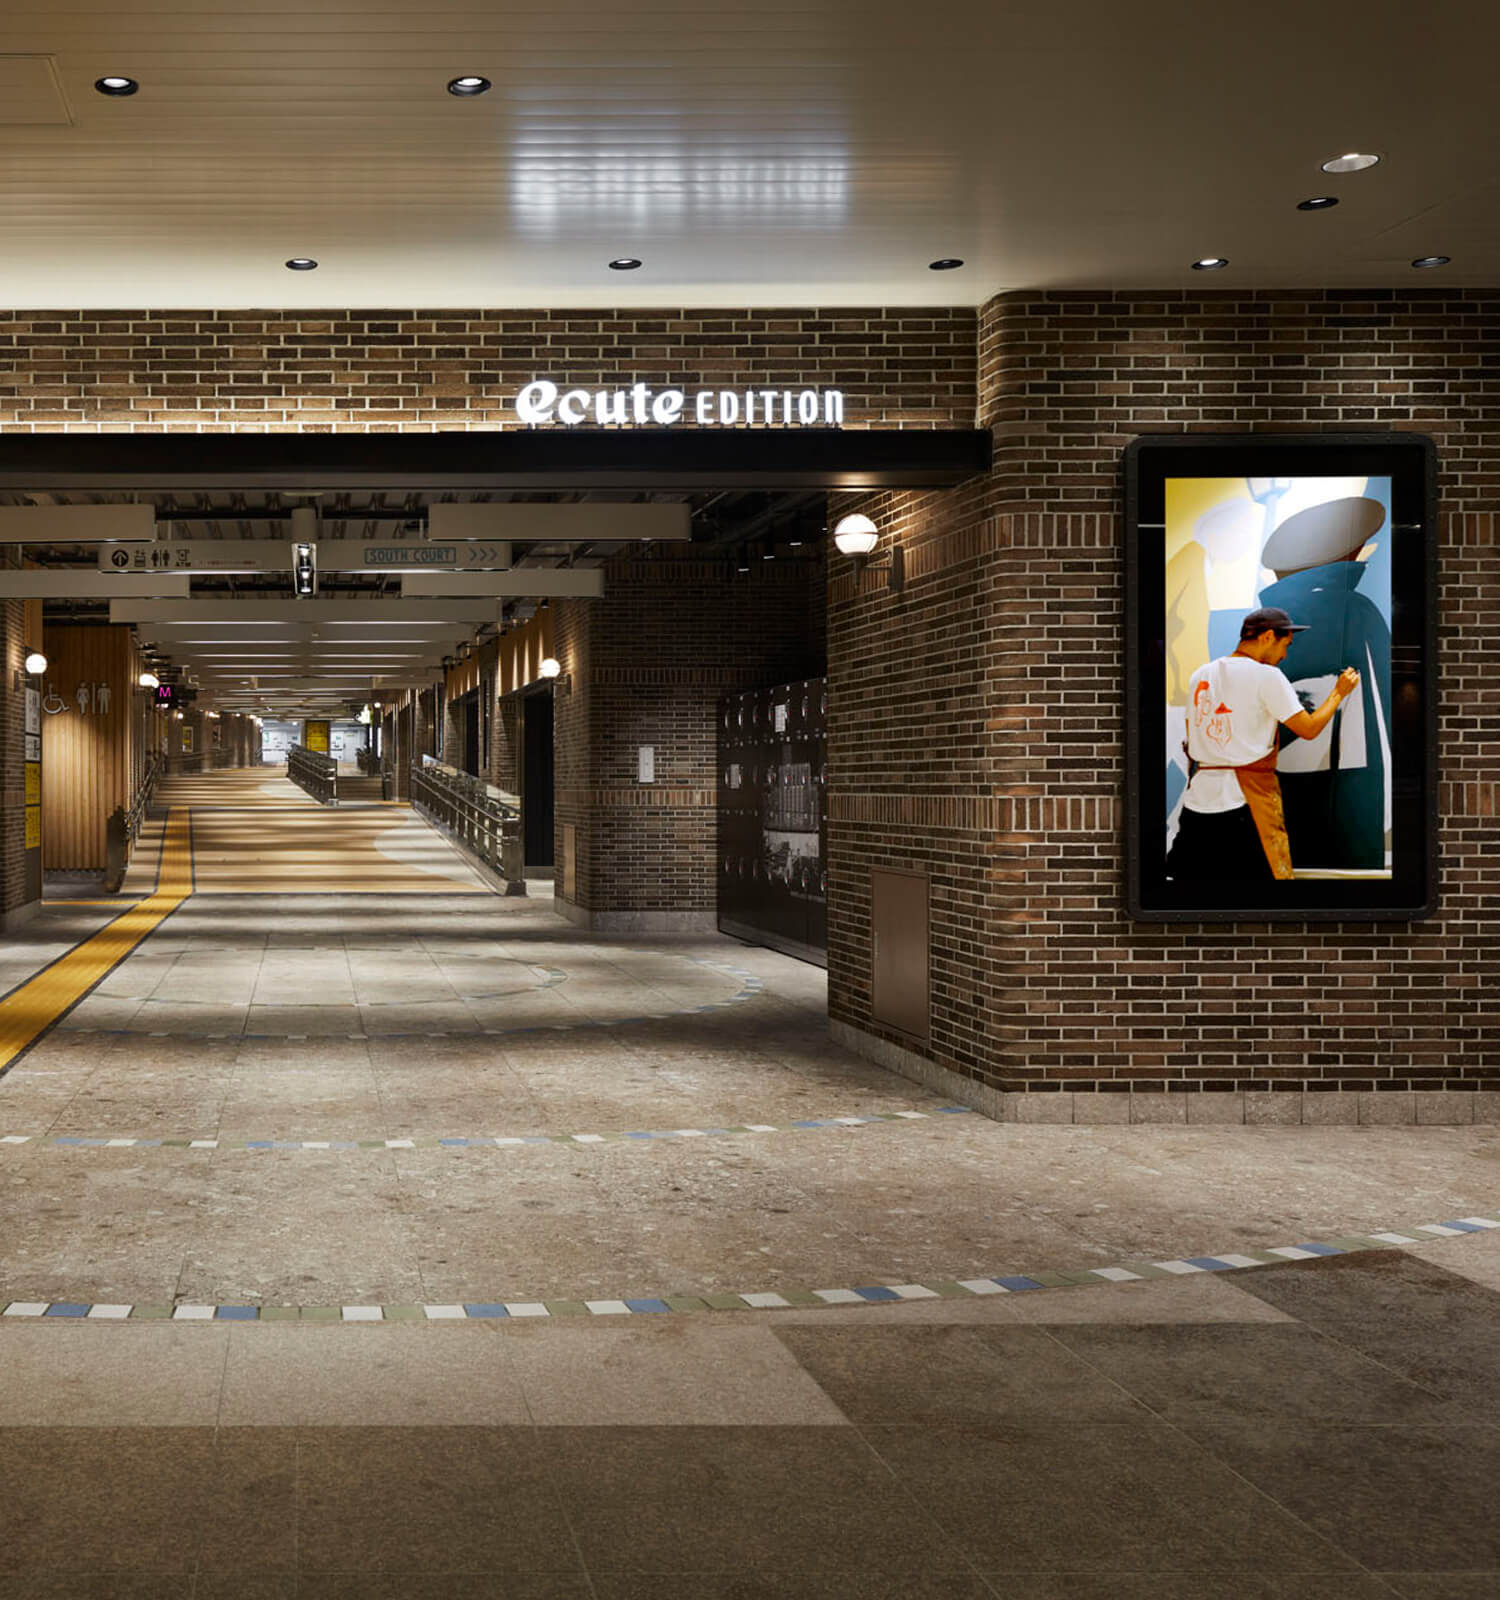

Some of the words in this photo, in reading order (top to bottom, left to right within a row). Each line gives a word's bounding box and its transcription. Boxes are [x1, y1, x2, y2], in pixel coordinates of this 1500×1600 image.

[515, 380, 685, 424] ecute
[696, 389, 844, 425] EDITION
[370, 550, 408, 562] SOUTH
[413, 550, 450, 562] COURT
[159, 686, 171, 697] M
